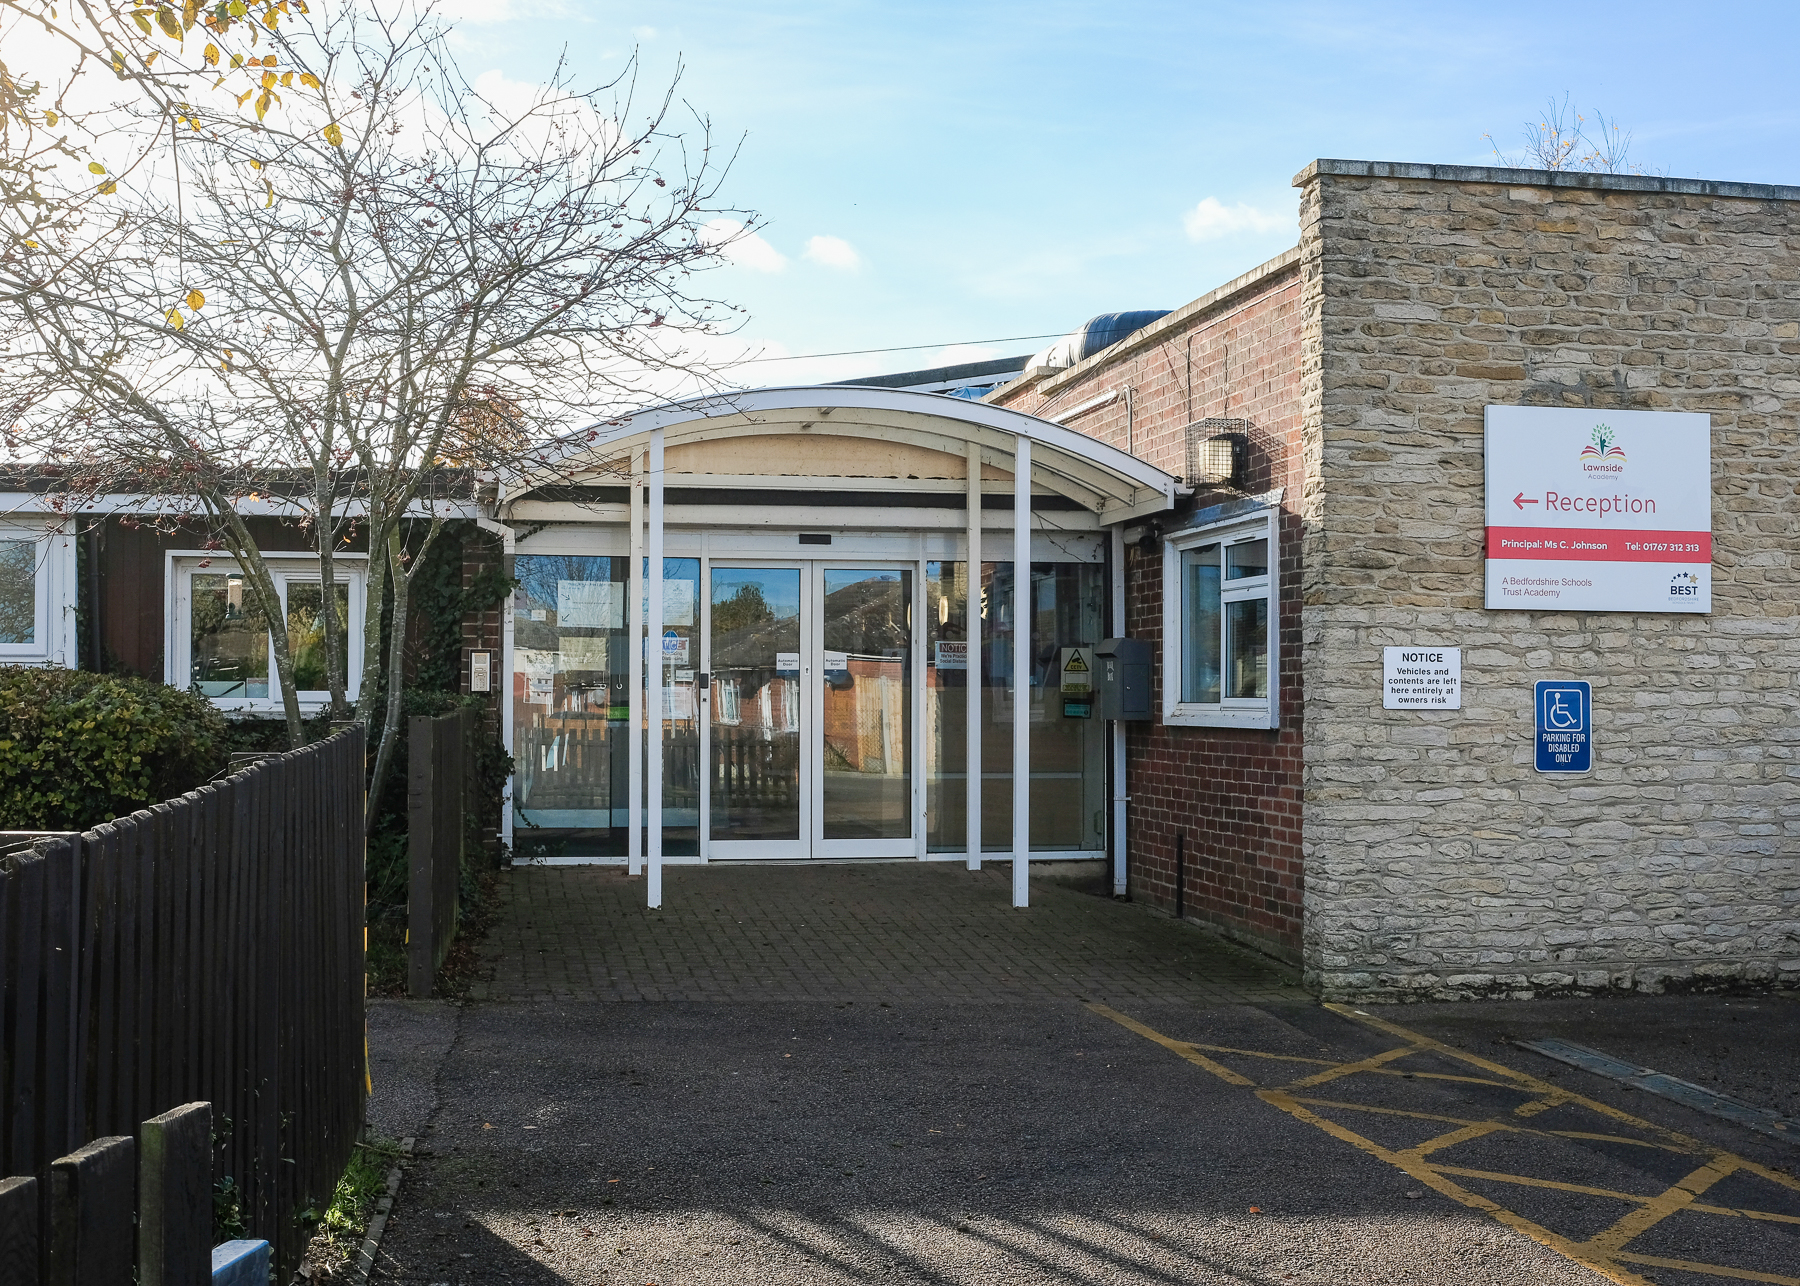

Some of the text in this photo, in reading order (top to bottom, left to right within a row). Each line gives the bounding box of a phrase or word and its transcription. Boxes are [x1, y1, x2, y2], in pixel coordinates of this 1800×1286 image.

[1583, 463, 1623, 473] Lawnside
[1587, 473, 1618, 481] Academy
[1546, 491, 1656, 518] Reception
[1501, 539, 1608, 551] Principal: Ms C. Johnson
[1625, 542, 1700, 552] Tel: 01767 312 313
[1502, 577, 1593, 587] A Bedfordshire Schools
[1502, 588, 1561, 598] Trust Academy
[1670, 585, 1699, 595] BEST
[941, 643, 967, 653] NOTIC
[1402, 653, 1443, 663] NOTICE
[1396, 667, 1449, 676] Vehicles and
[1388, 677, 1424, 685] contents
[1443, 677, 1457, 685] left
[1391, 686, 1409, 694] here
[1412, 687, 1443, 696] entirely
[1431, 696, 1447, 704] risk
[1542, 733, 1586, 743] PARKING FOR
[1548, 743, 1580, 753] DISABLED
[1555, 754, 1573, 763] ONLY
